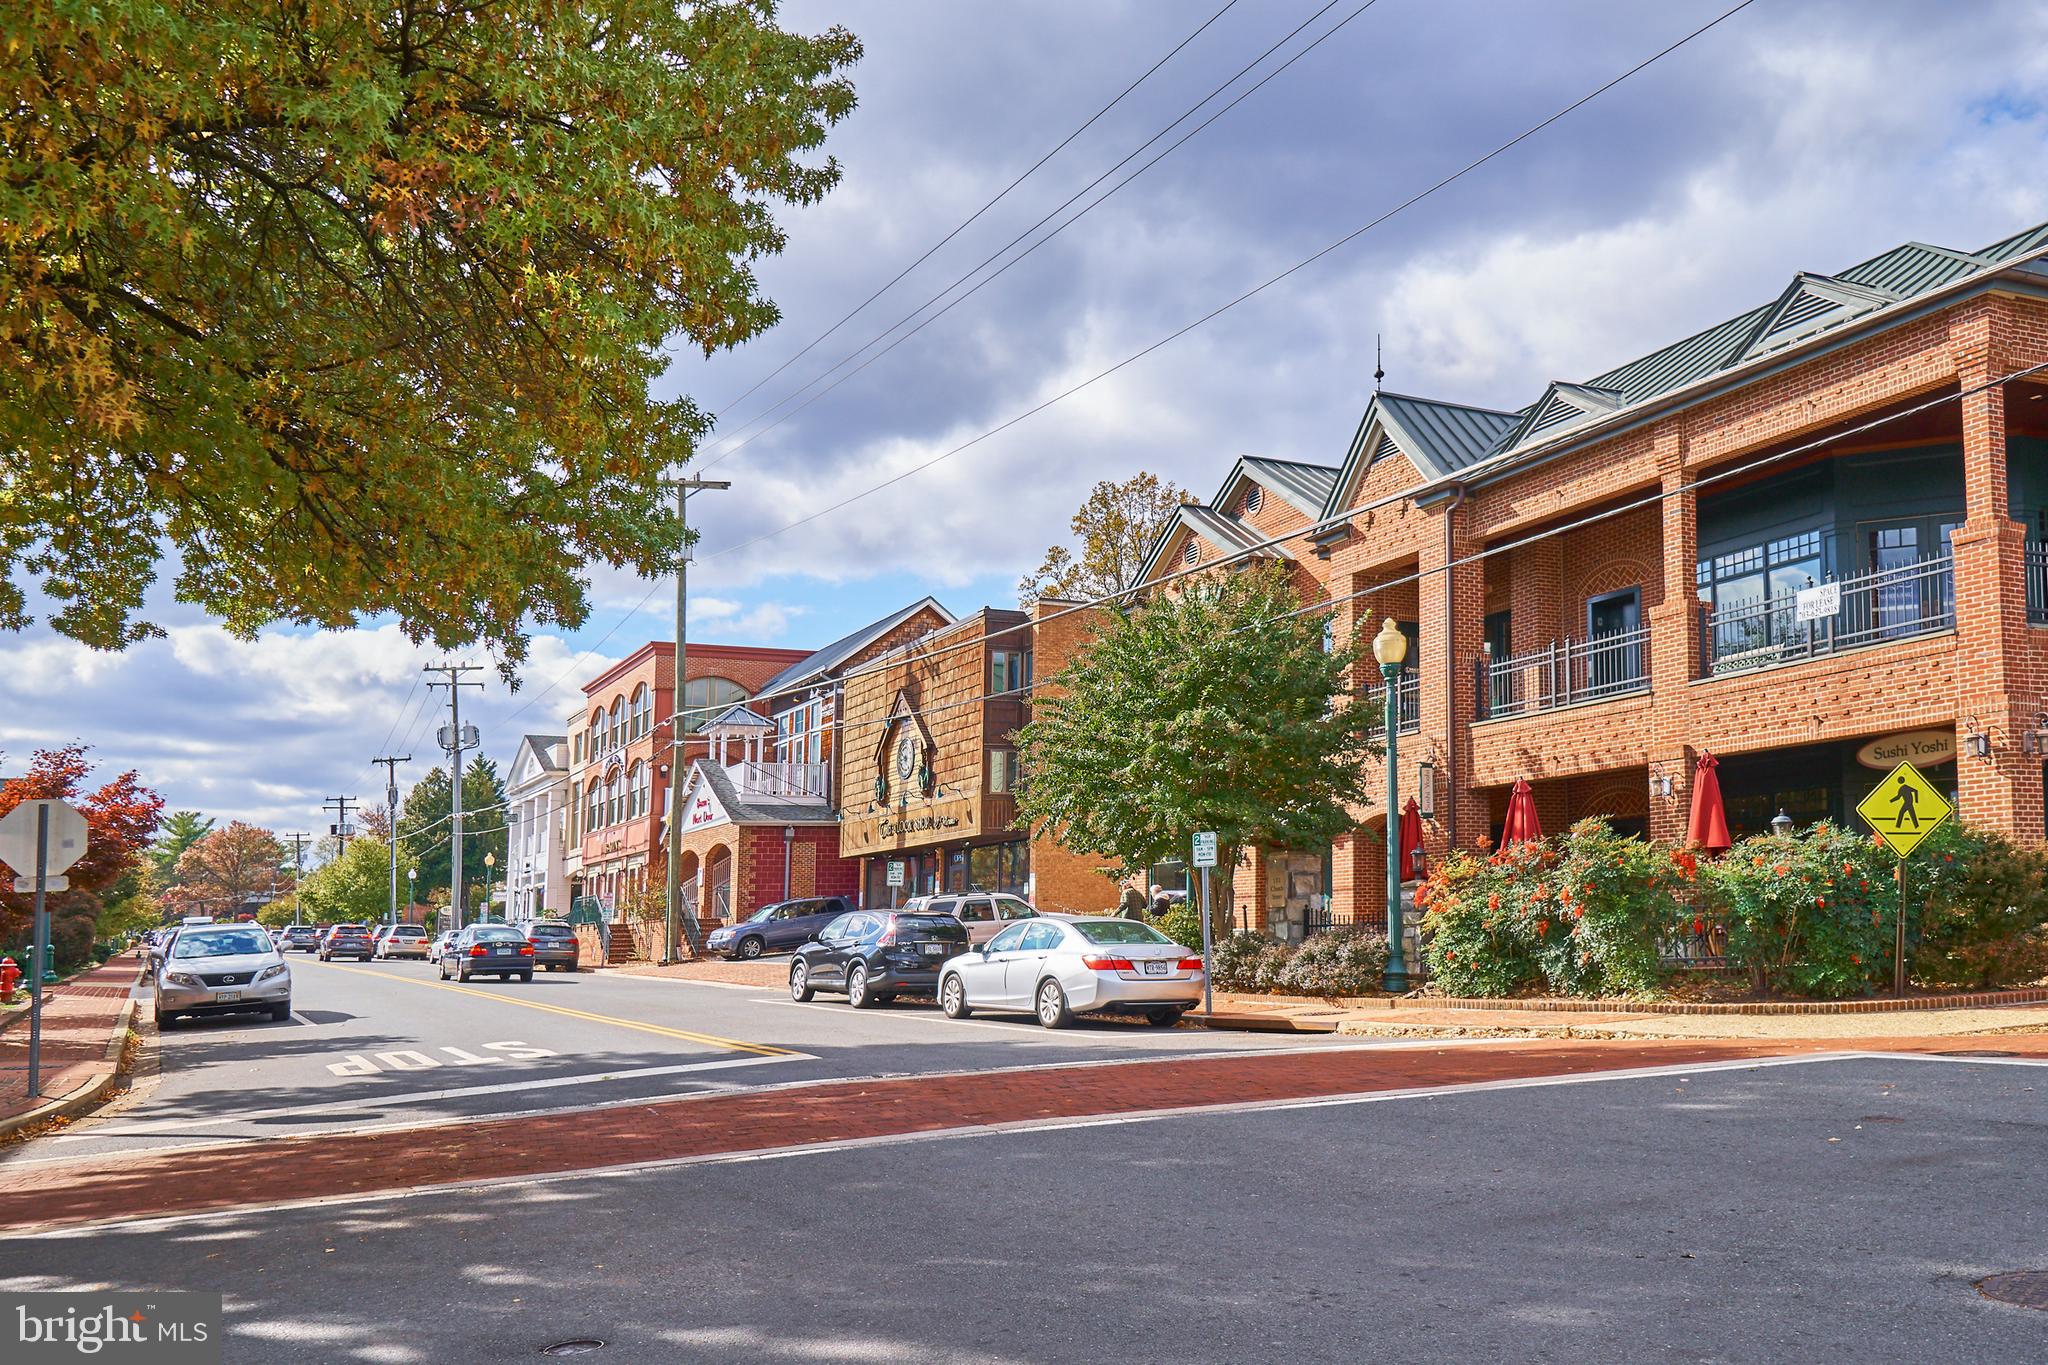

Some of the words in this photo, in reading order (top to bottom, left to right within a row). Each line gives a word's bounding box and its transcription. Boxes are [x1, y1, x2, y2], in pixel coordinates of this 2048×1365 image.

[1820, 586, 1838, 597] SPACE
[1803, 601, 1815, 610] FOR
[1816, 596, 1833, 607] LEASE
[1873, 745, 1908, 760] Sushi
[1911, 738, 1949, 755] Yoshi
[1194, 835, 1201, 845] 2
[325, 1041, 559, 1077] STOP
